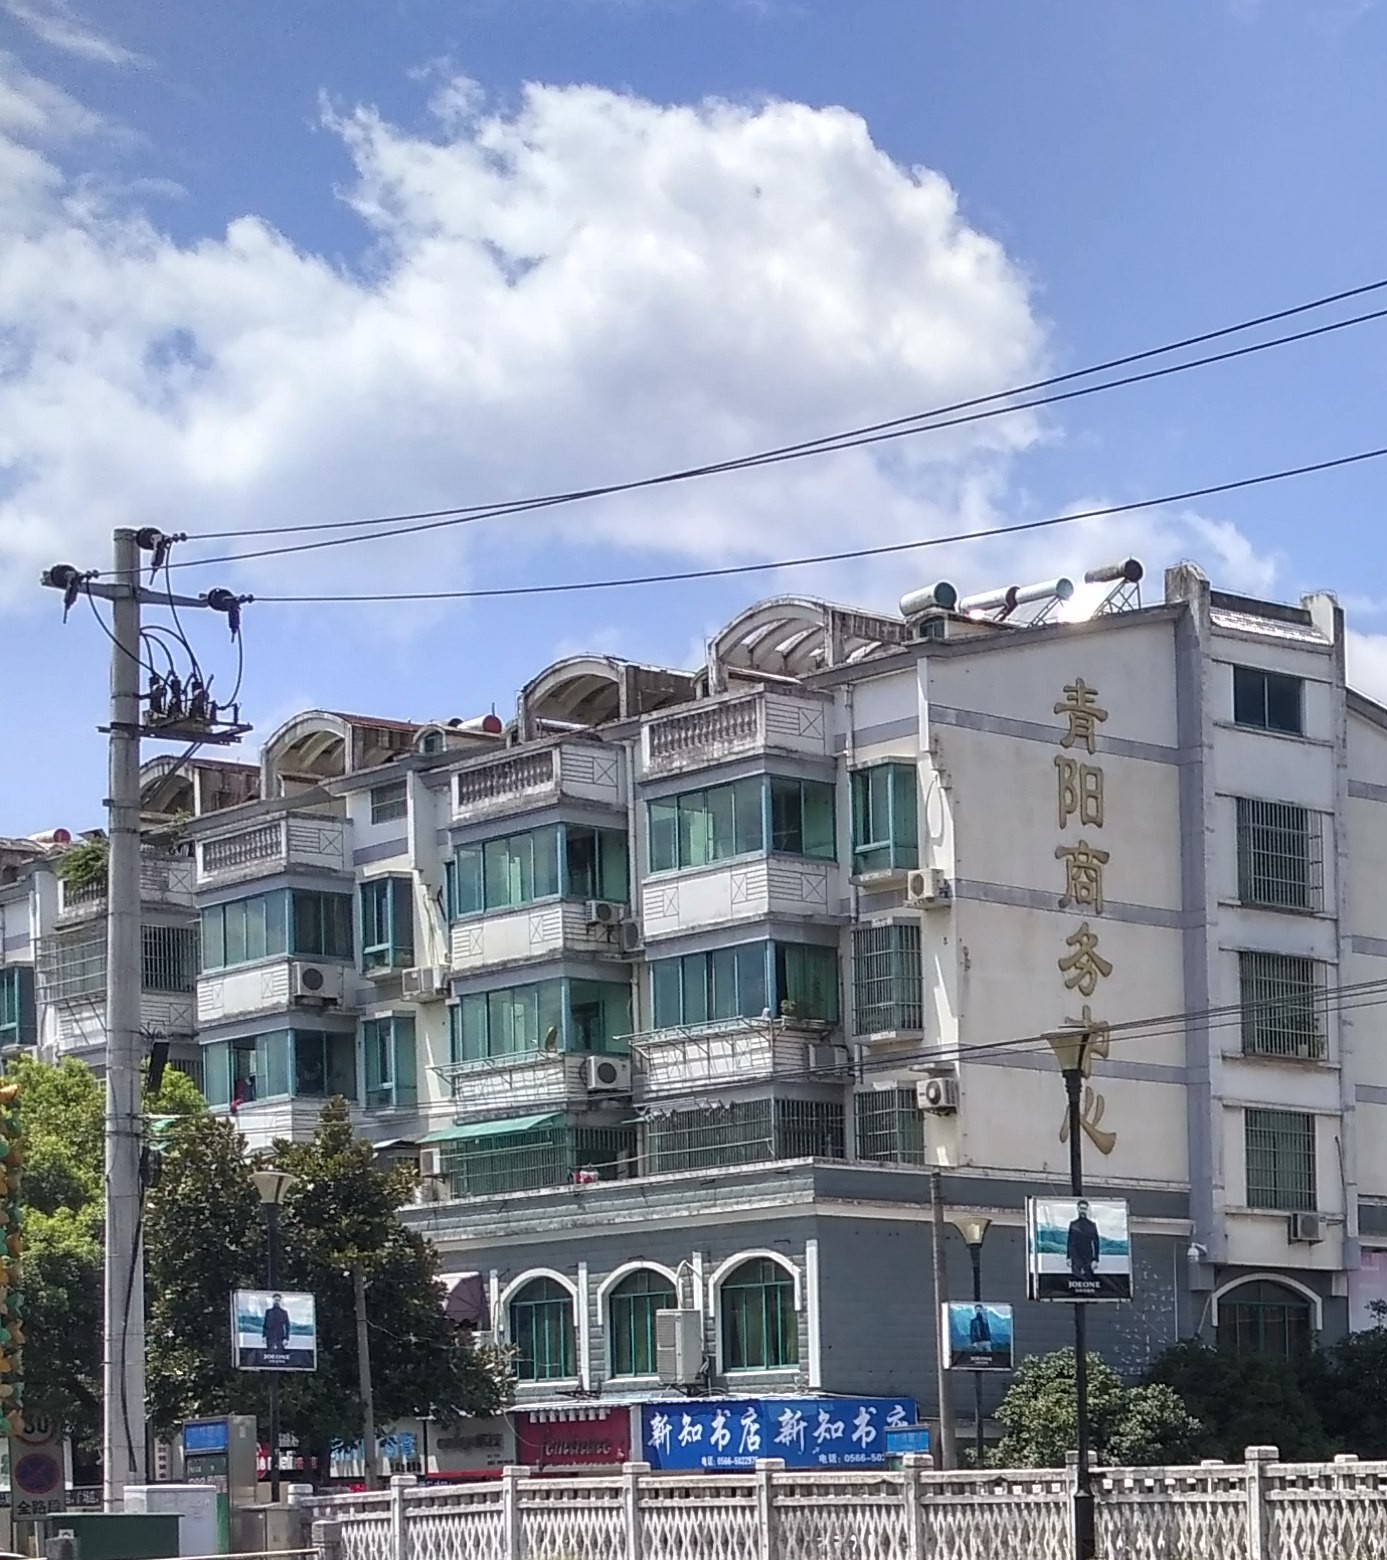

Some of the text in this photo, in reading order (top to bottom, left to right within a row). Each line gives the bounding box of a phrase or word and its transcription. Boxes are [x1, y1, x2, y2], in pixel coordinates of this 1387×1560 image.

[1053, 677, 1118, 1156] 青阳商务中心
[647, 1407, 760, 1455] 新知书店
